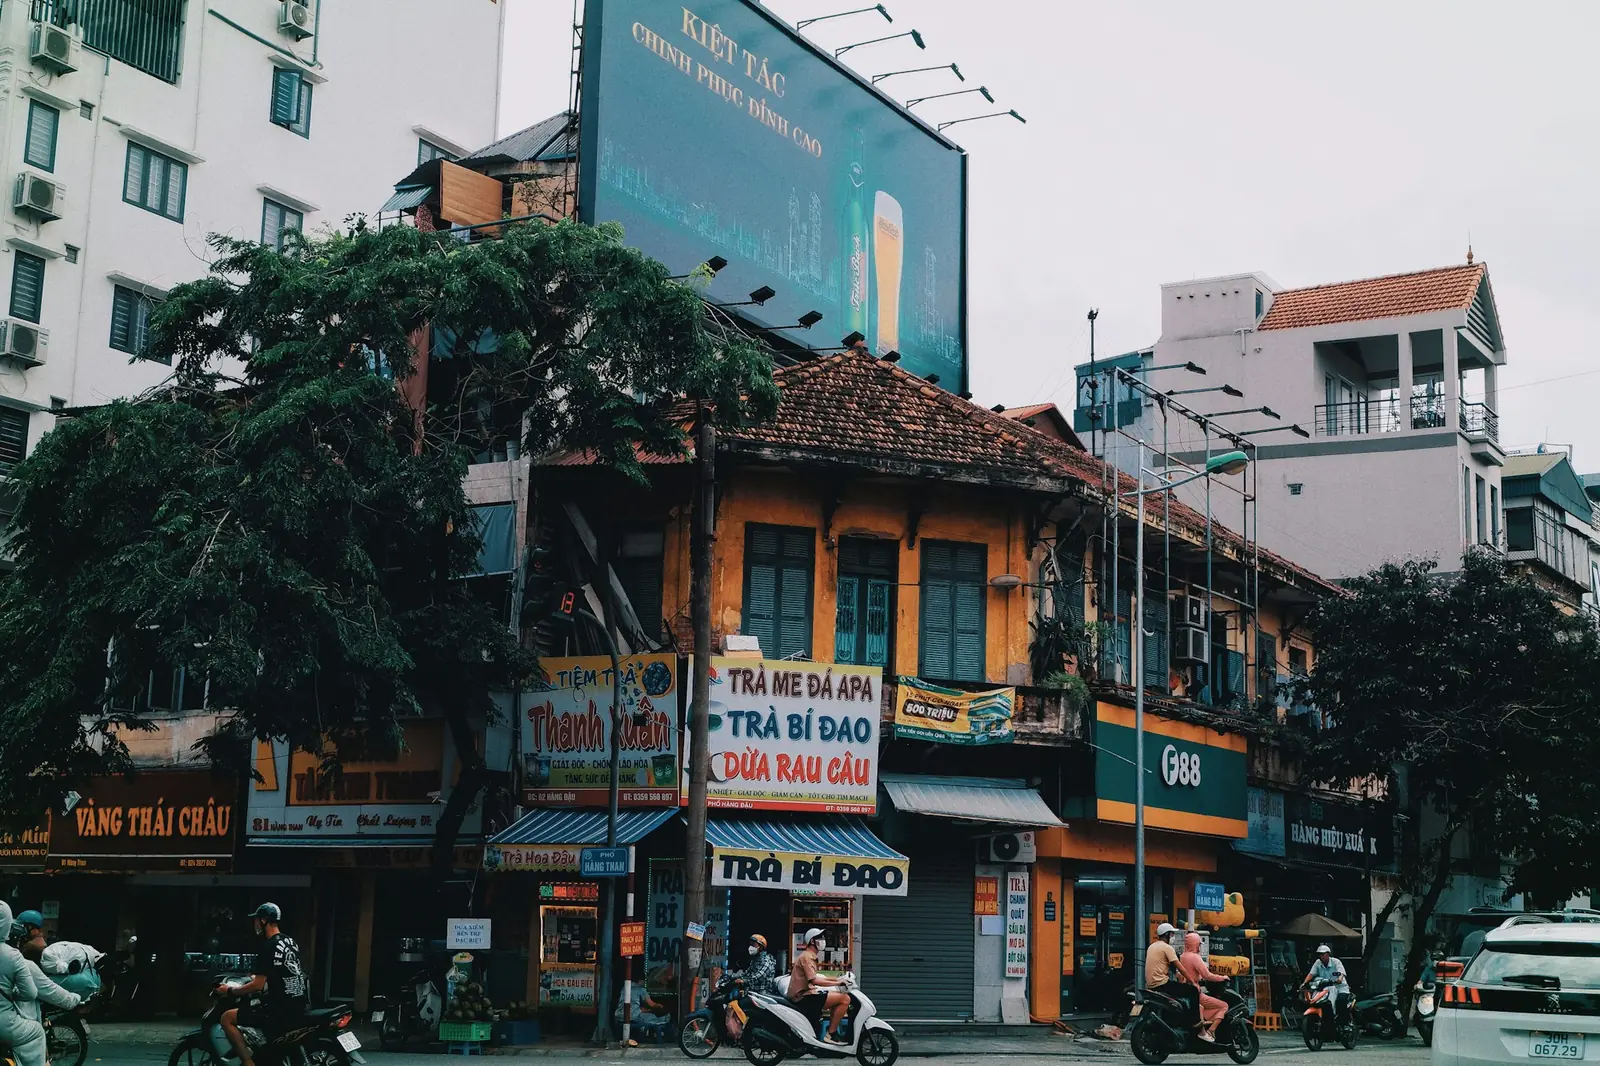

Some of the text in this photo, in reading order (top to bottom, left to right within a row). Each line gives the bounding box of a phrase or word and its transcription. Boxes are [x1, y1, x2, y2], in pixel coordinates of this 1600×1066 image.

[632, 22, 692, 76] CHINH
[696, 62, 743, 108] PHỤC
[792, 127, 822, 158] CAO
[742, 49, 785, 98] TÁC
[728, 663, 767, 697] TRÀ
[773, 671, 802, 698] ME
[807, 667, 833, 700] ĐÁ
[837, 675, 873, 702] APA
[528, 698, 604, 753] Thanh
[727, 705, 872, 744] TRÀ BÍ ĐAO
[906, 703, 954, 721] 500 TRIỆU
[723, 746, 870, 786] DỪA RAU CÂU
[76, 796, 231, 837] VÀNG THÁI CHÂU
[1291, 820, 1321, 845] HÀNG
[1321, 825, 1344, 853] HIỆU
[503, 849, 522, 865] Trà
[525, 851, 549, 865] Hoa
[585, 859, 625, 873] HÀNG THAN
[600, 851, 615, 859] PHỐ
[719, 853, 903, 890] TRÀ BÍ ĐAO
[1010, 873, 1026, 892] TRÀ
[1009, 894, 1027, 905] CHANH
[1534, 1044, 1577, 1057] 067.29
[1545, 1033, 1569, 1045] 30H
